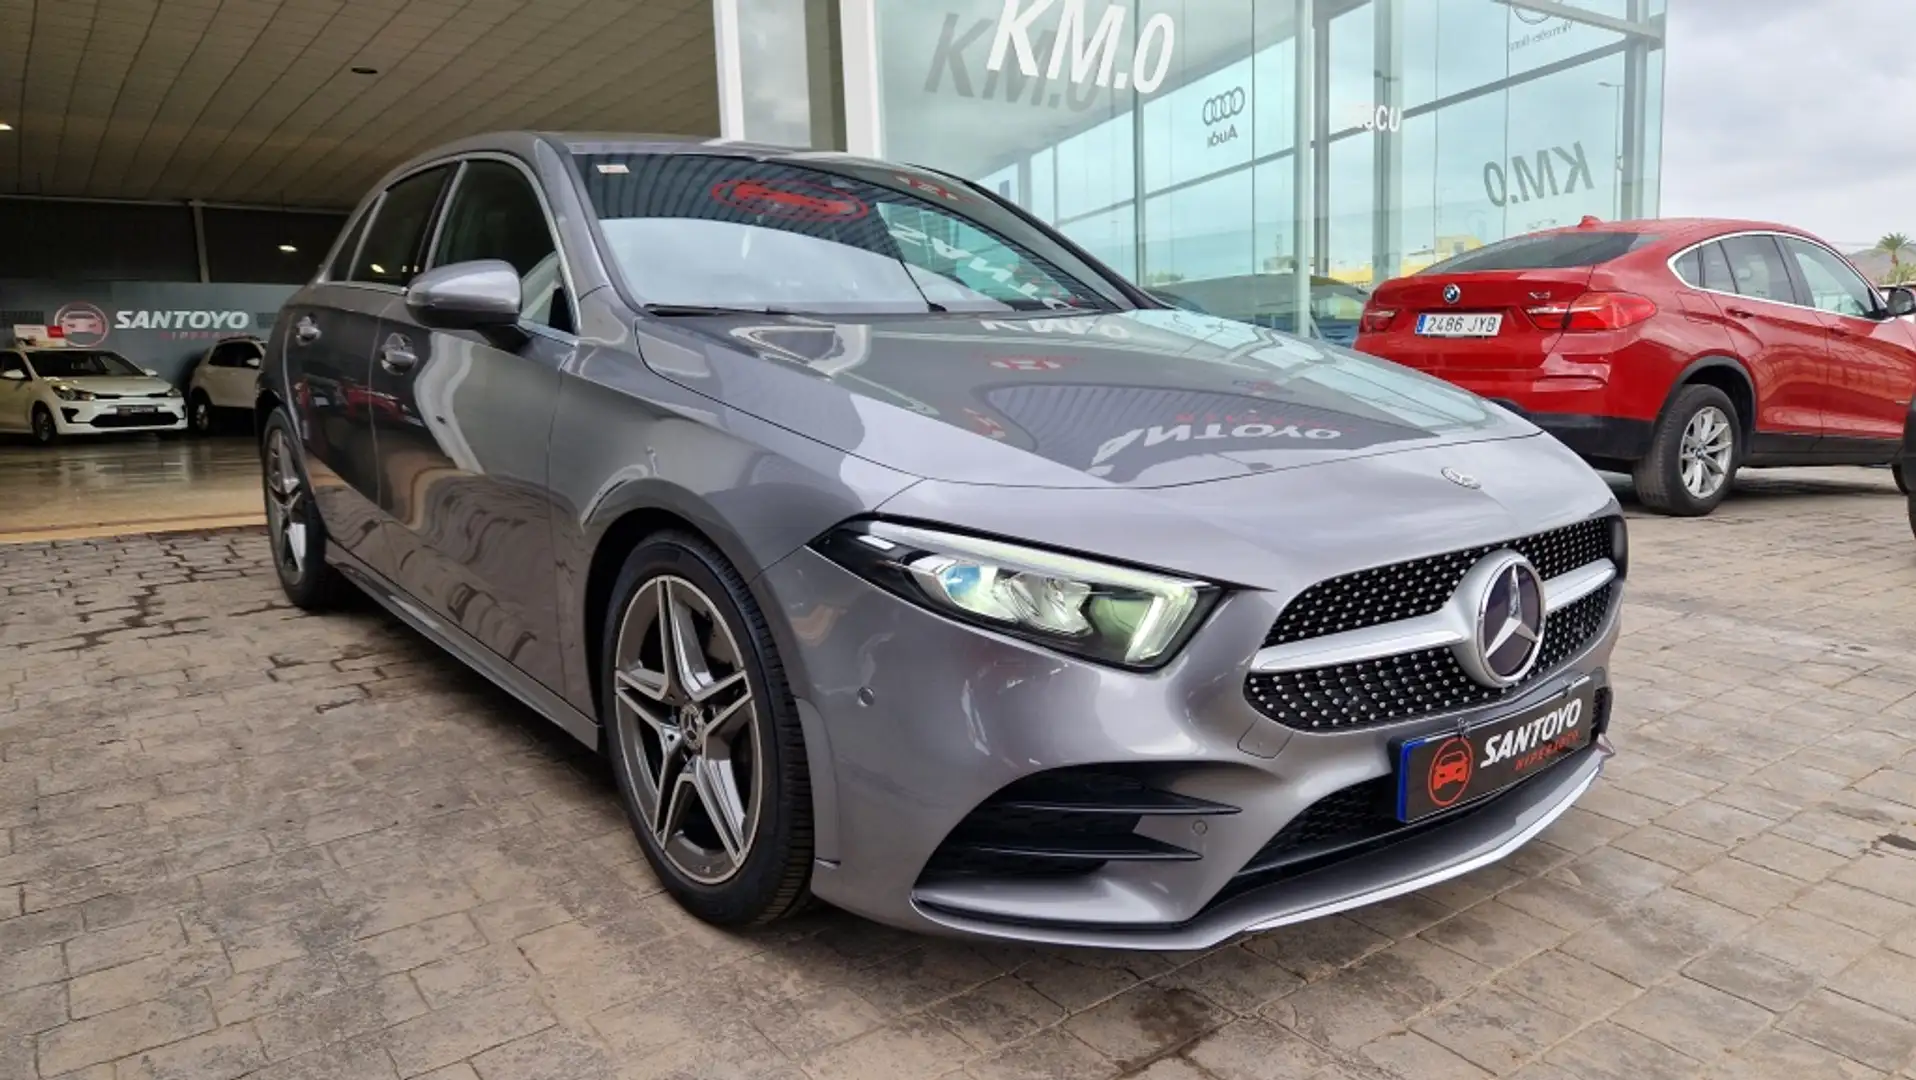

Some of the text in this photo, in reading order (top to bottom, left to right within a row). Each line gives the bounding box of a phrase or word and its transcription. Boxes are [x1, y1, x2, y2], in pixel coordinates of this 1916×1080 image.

[987, 0, 1175, 93] KM.0
[114, 310, 250, 329] SANTOYO
[1480, 698, 1582, 768] SANTOYO
